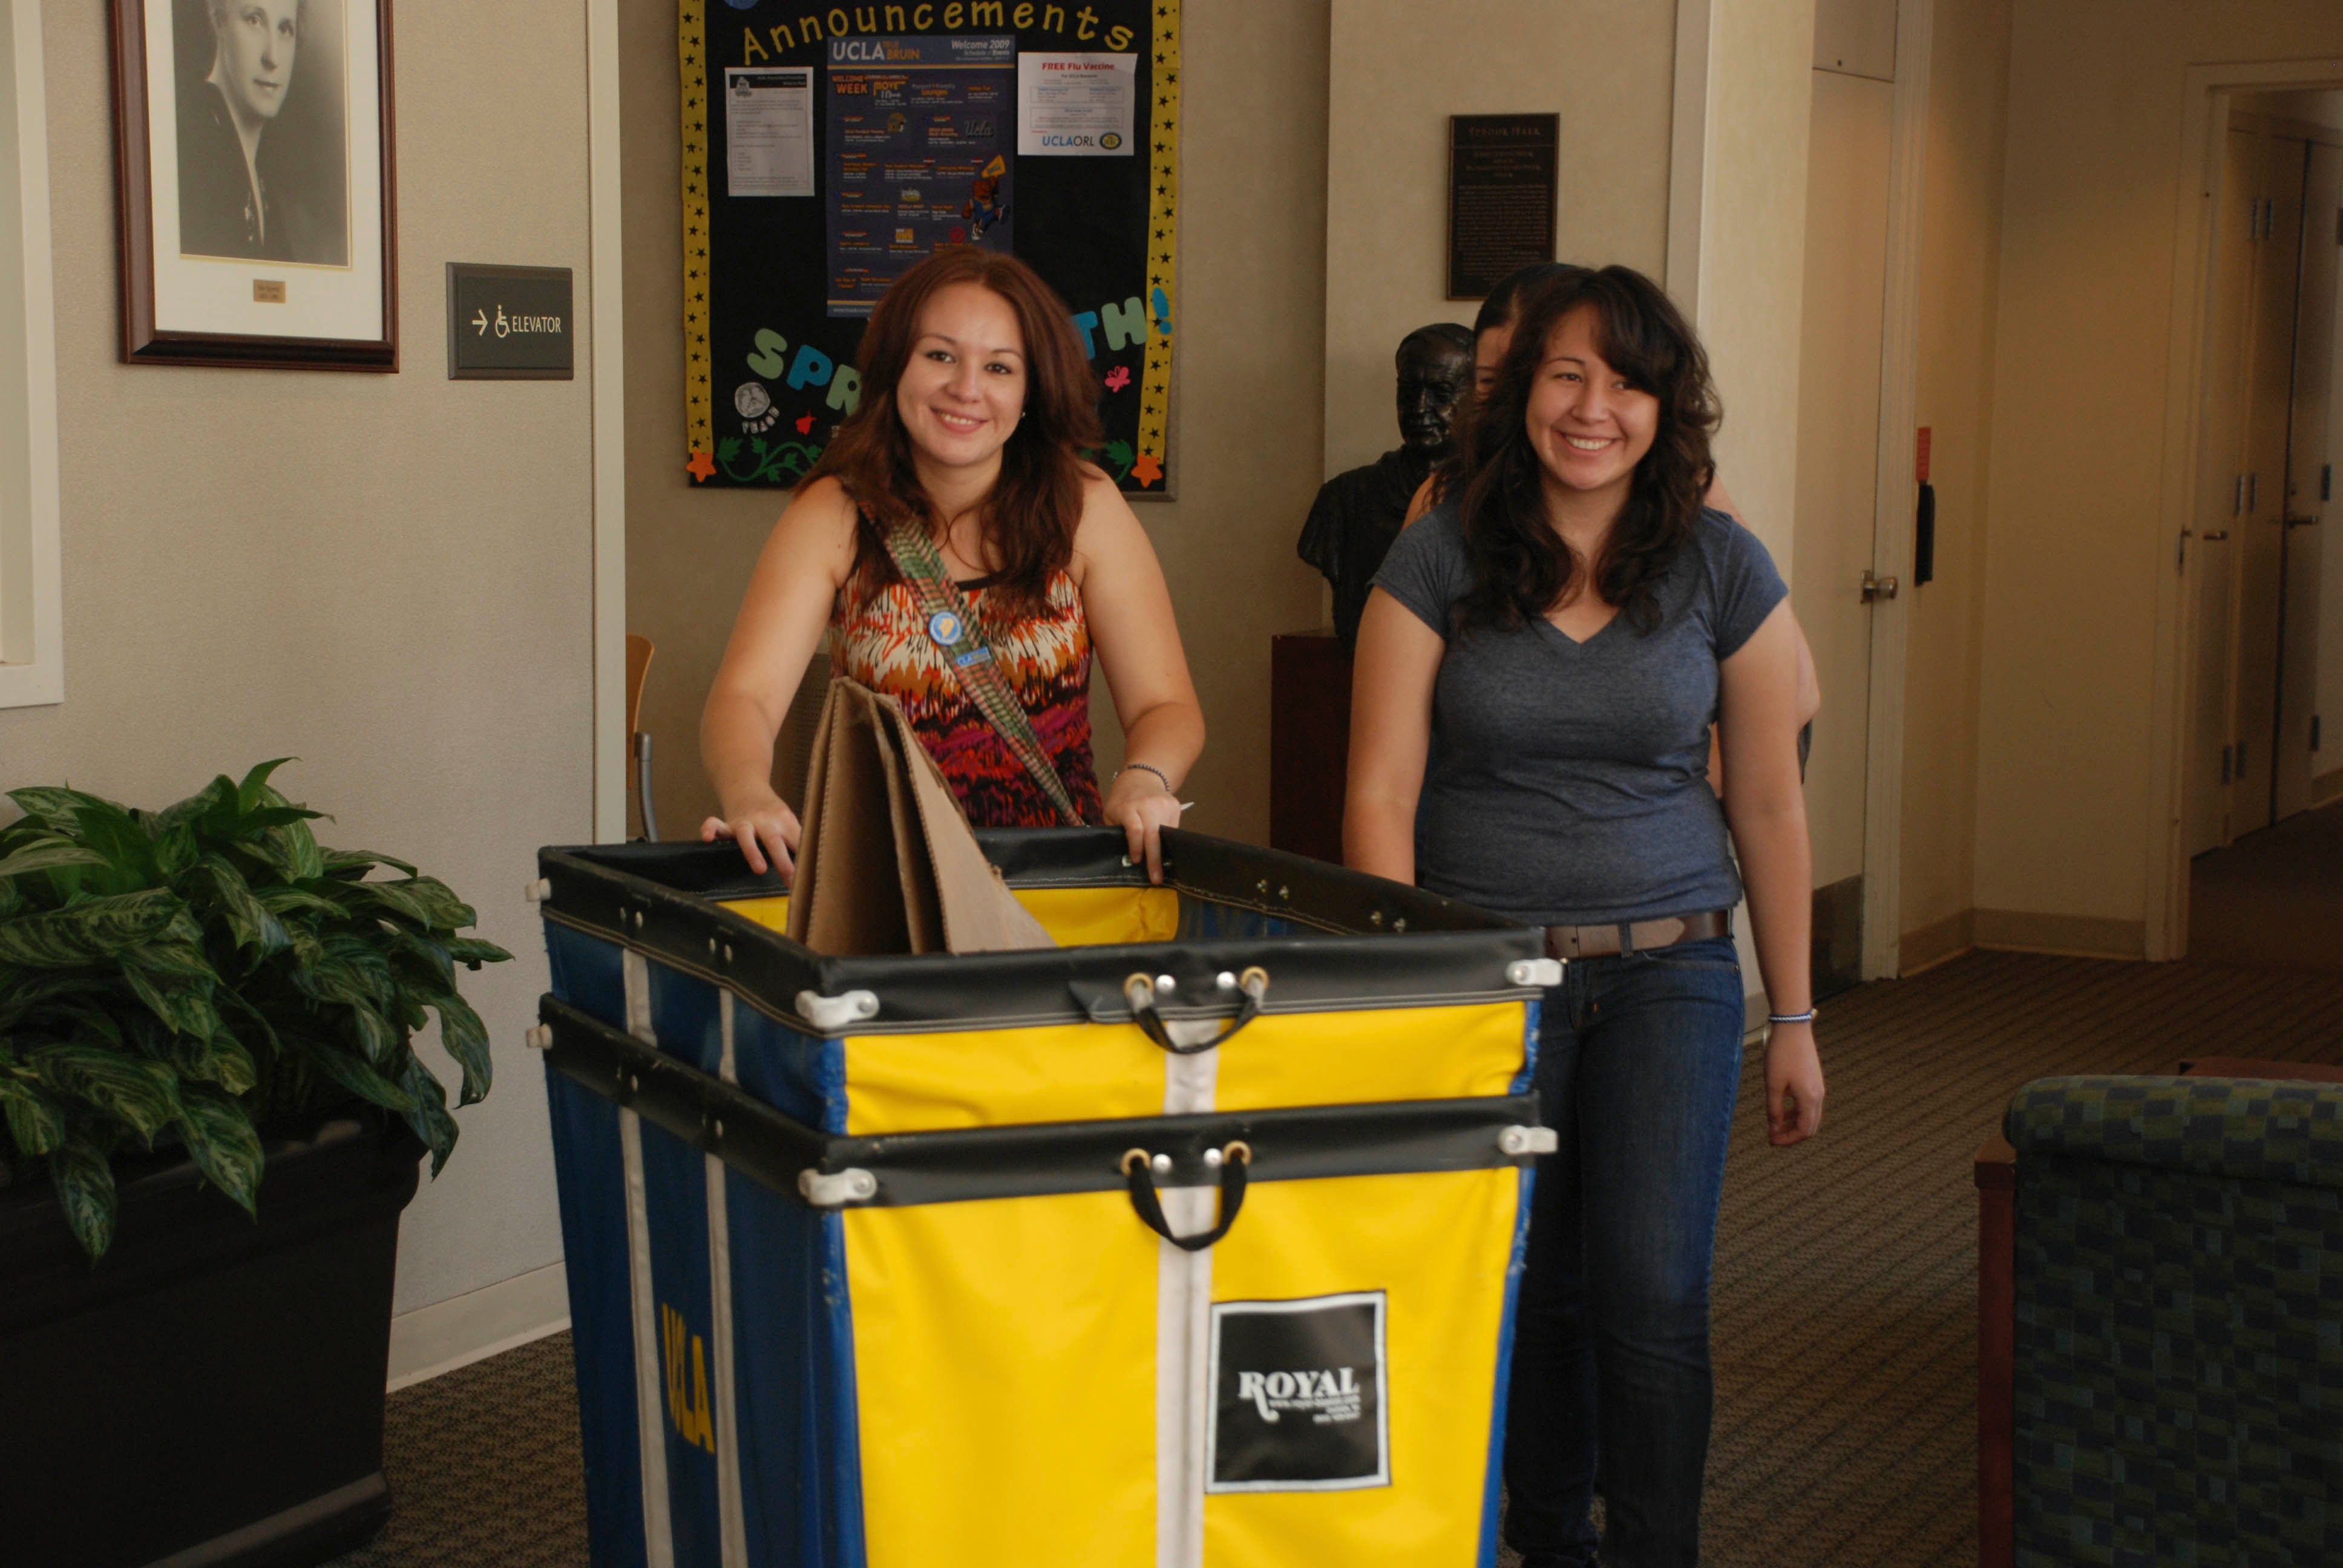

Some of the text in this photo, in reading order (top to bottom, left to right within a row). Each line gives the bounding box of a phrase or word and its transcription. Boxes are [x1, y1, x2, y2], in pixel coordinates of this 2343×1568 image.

[744, 1, 1135, 66] Announcements
[833, 41, 885, 60] UCLA
[951, 39, 1010, 50] Welcome 2009
[886, 48, 920, 60] BRUIN
[836, 83, 868, 94] WEEK
[512, 316, 562, 333] ELEVATOR
[747, 327, 862, 417] SPR
[1237, 1367, 1360, 1423] ROYAL
